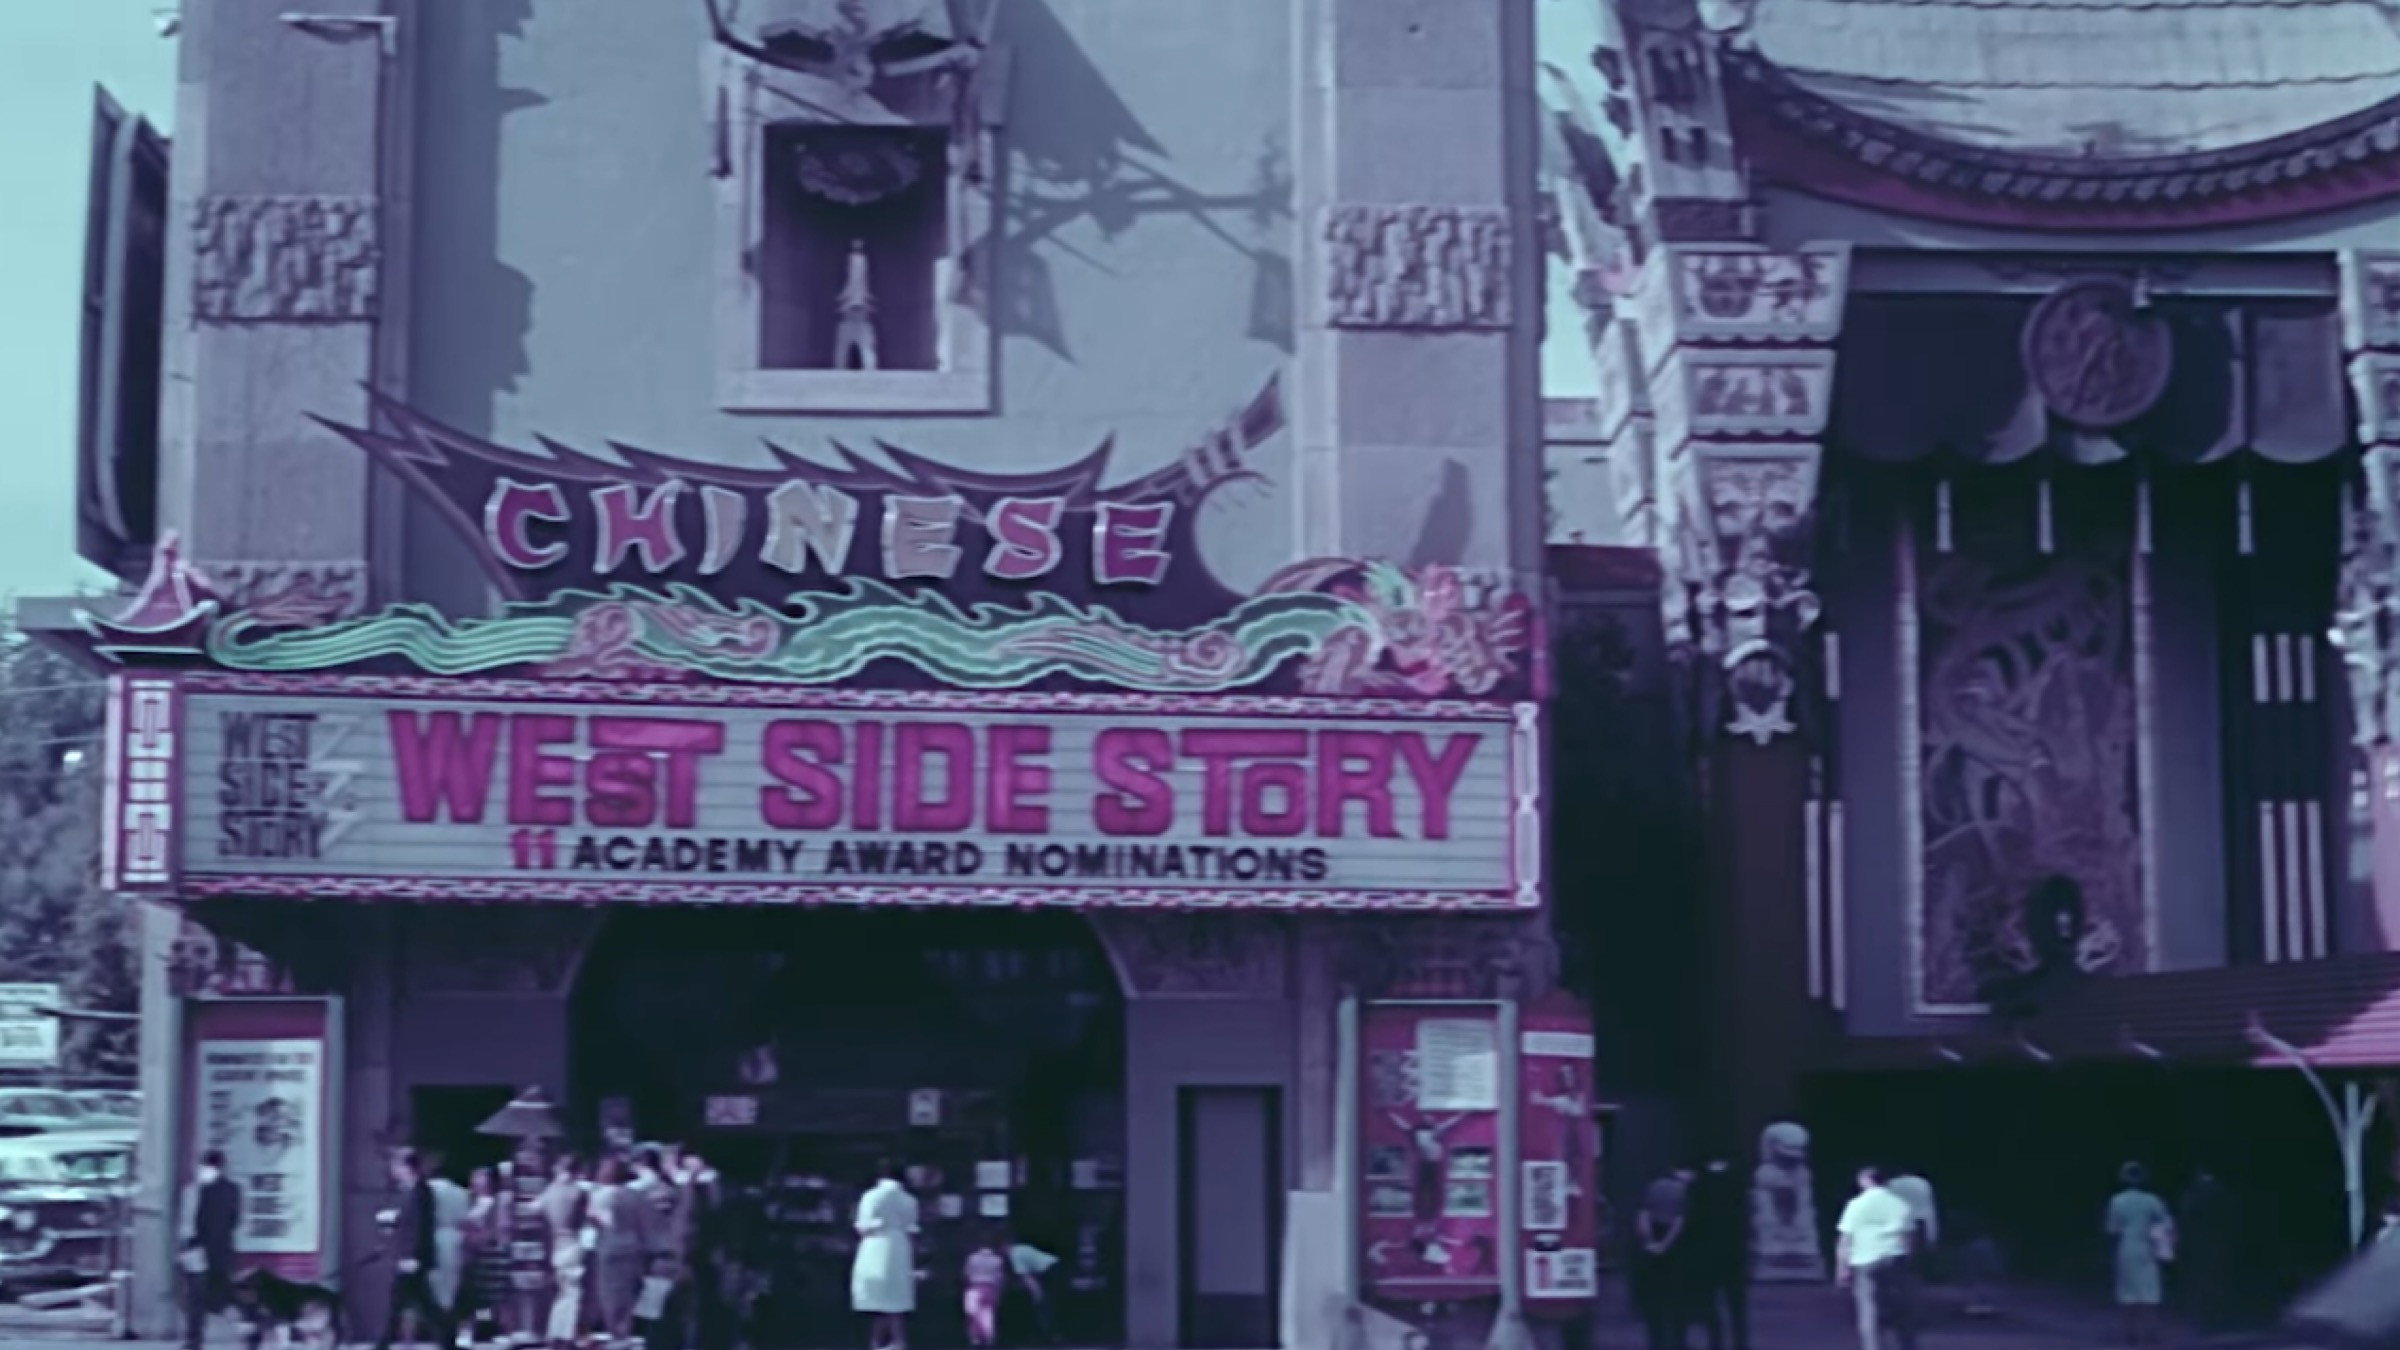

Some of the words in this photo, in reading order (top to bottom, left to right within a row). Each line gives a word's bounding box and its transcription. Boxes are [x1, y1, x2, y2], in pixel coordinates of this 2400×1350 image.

[485, 478, 1173, 584] CHINESE
[386, 709, 724, 829] WEST
[759, 718, 1052, 835] SIDE
[1092, 725, 1484, 840] STORY
[511, 829, 558, 871] 11
[571, 835, 803, 876] ACADEMY
[823, 839, 984, 879] AWARD
[1004, 841, 1329, 882] NOMINATIONS
